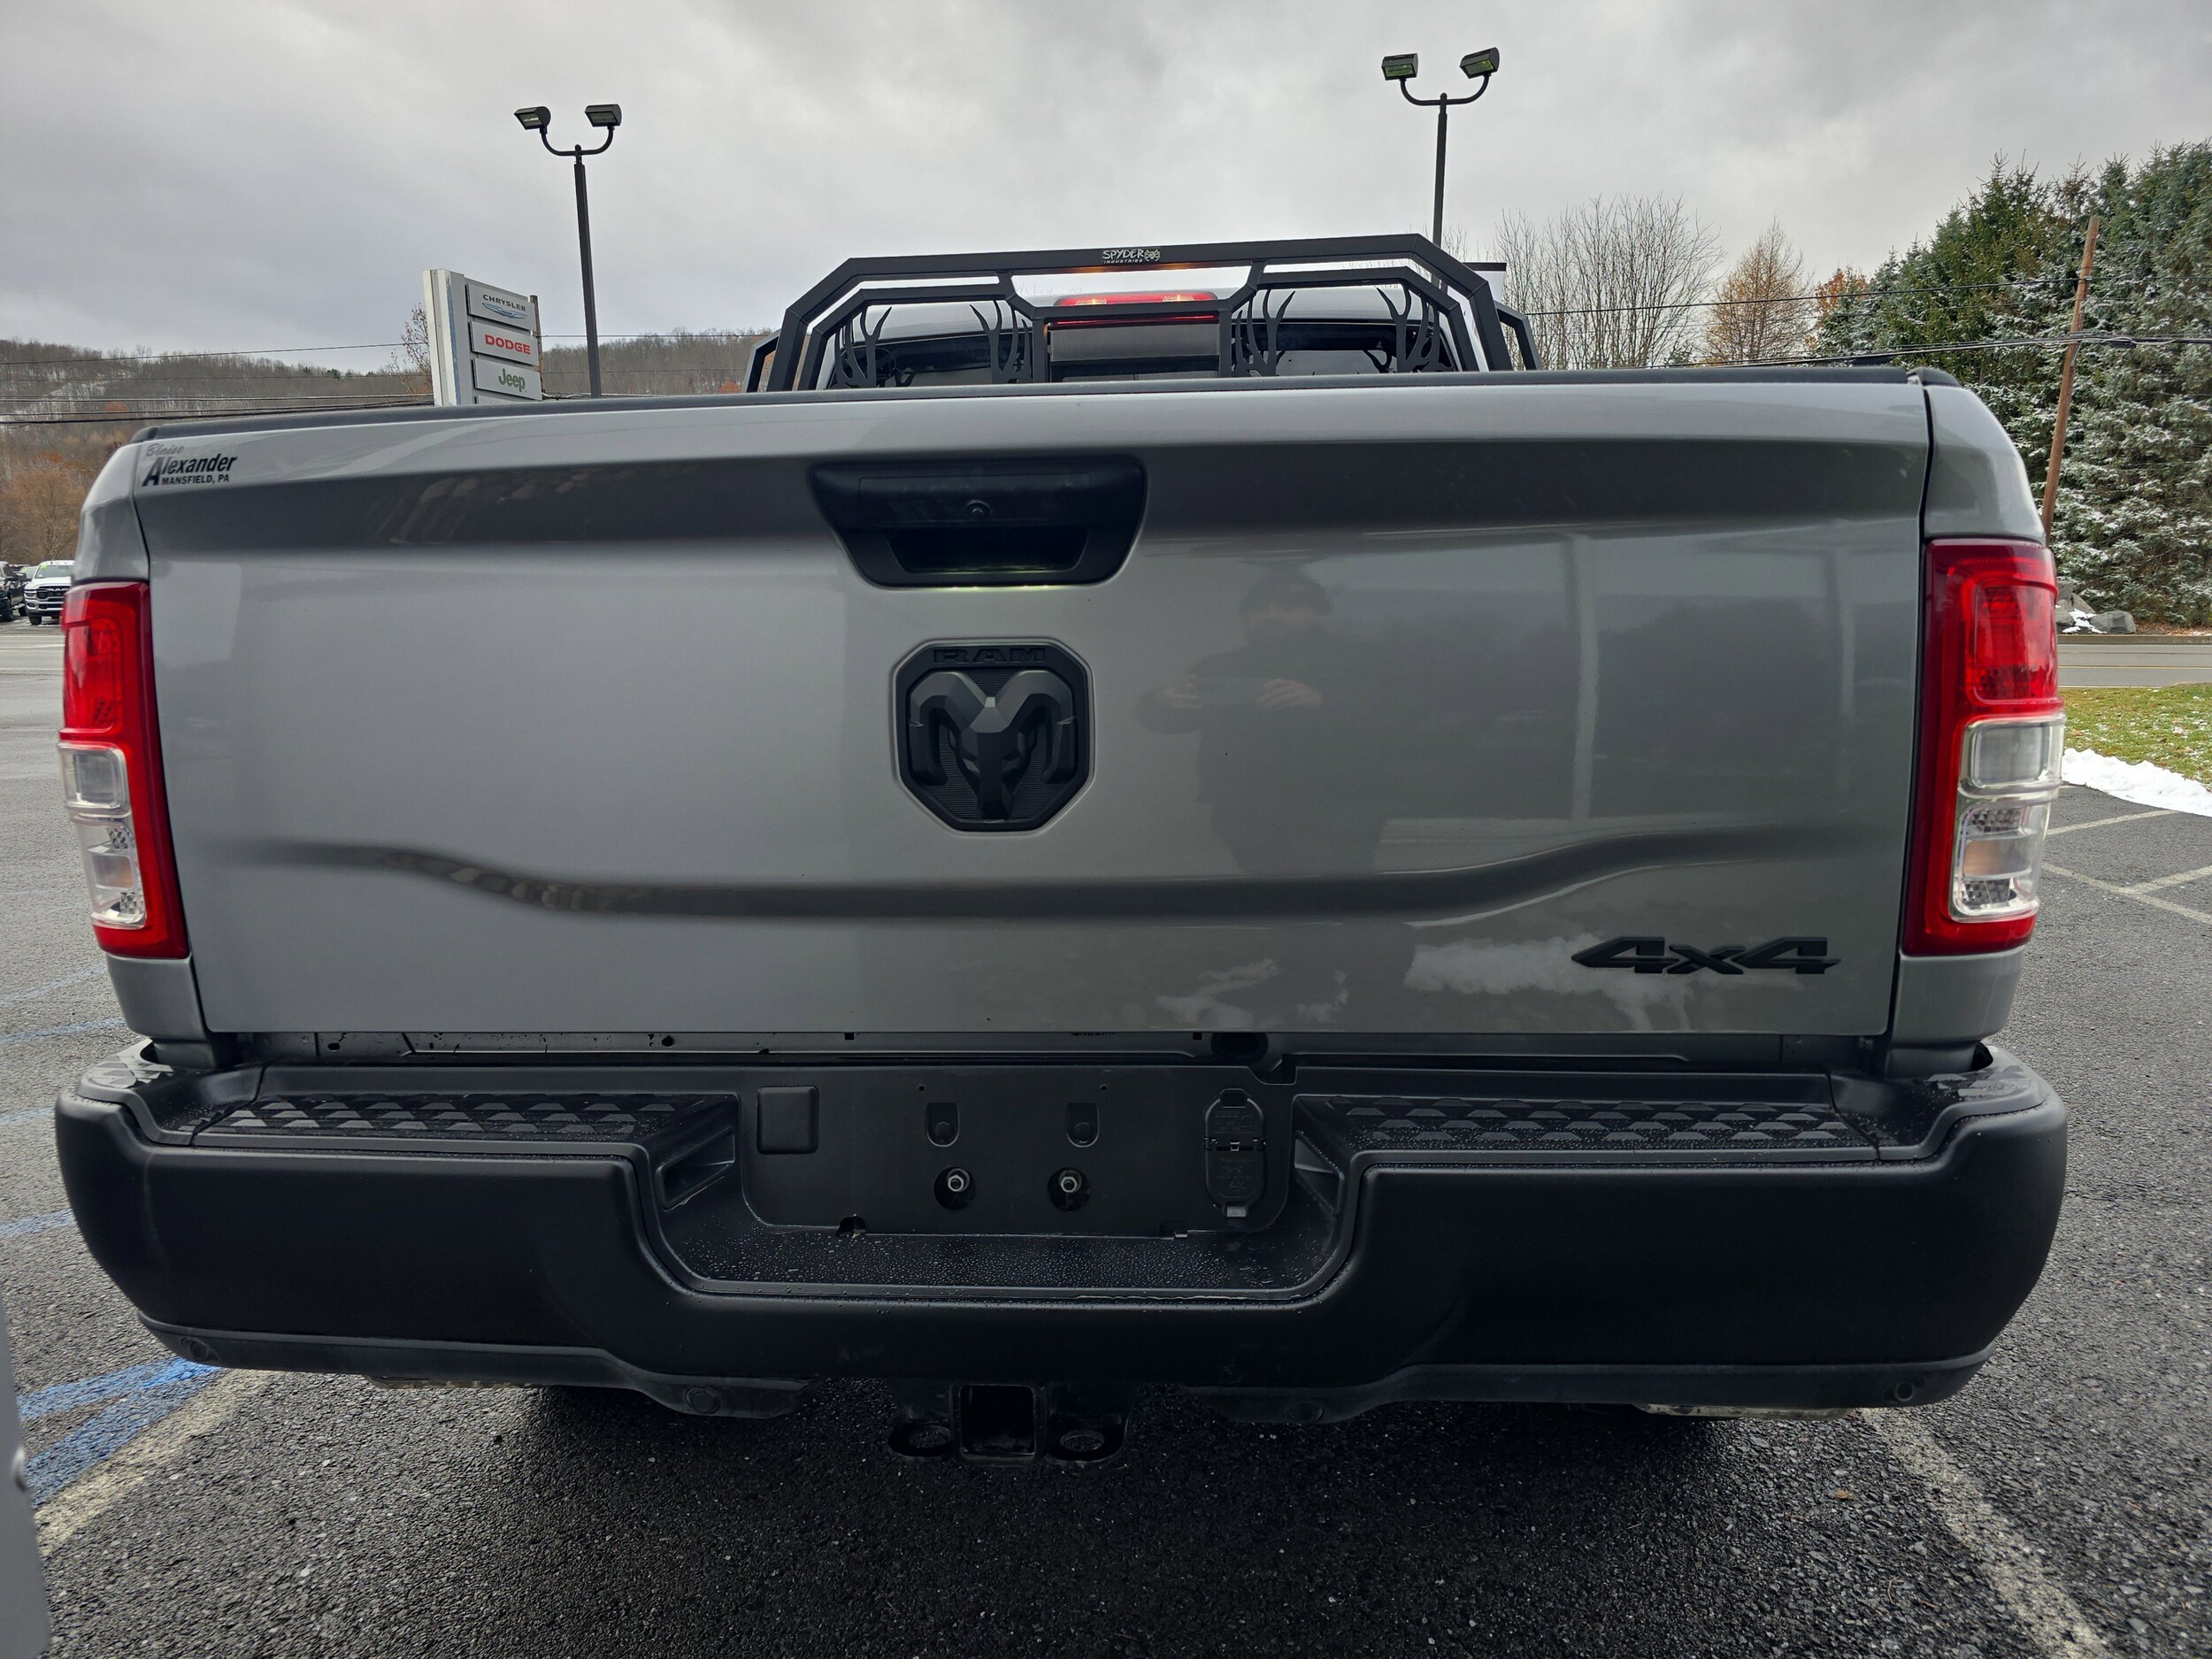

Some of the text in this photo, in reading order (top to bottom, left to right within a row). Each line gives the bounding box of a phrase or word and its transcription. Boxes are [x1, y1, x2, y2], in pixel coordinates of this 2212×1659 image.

[1102, 249, 1144, 259] SPYDER
[482, 294, 526, 311] CHRYSLER
[485, 334, 531, 354] DODGE
[498, 368, 526, 392] Jeep
[142, 453, 238, 487] Alexander
[161, 474, 215, 485] MANSFIELD,
[933, 648, 1046, 663] RAM
